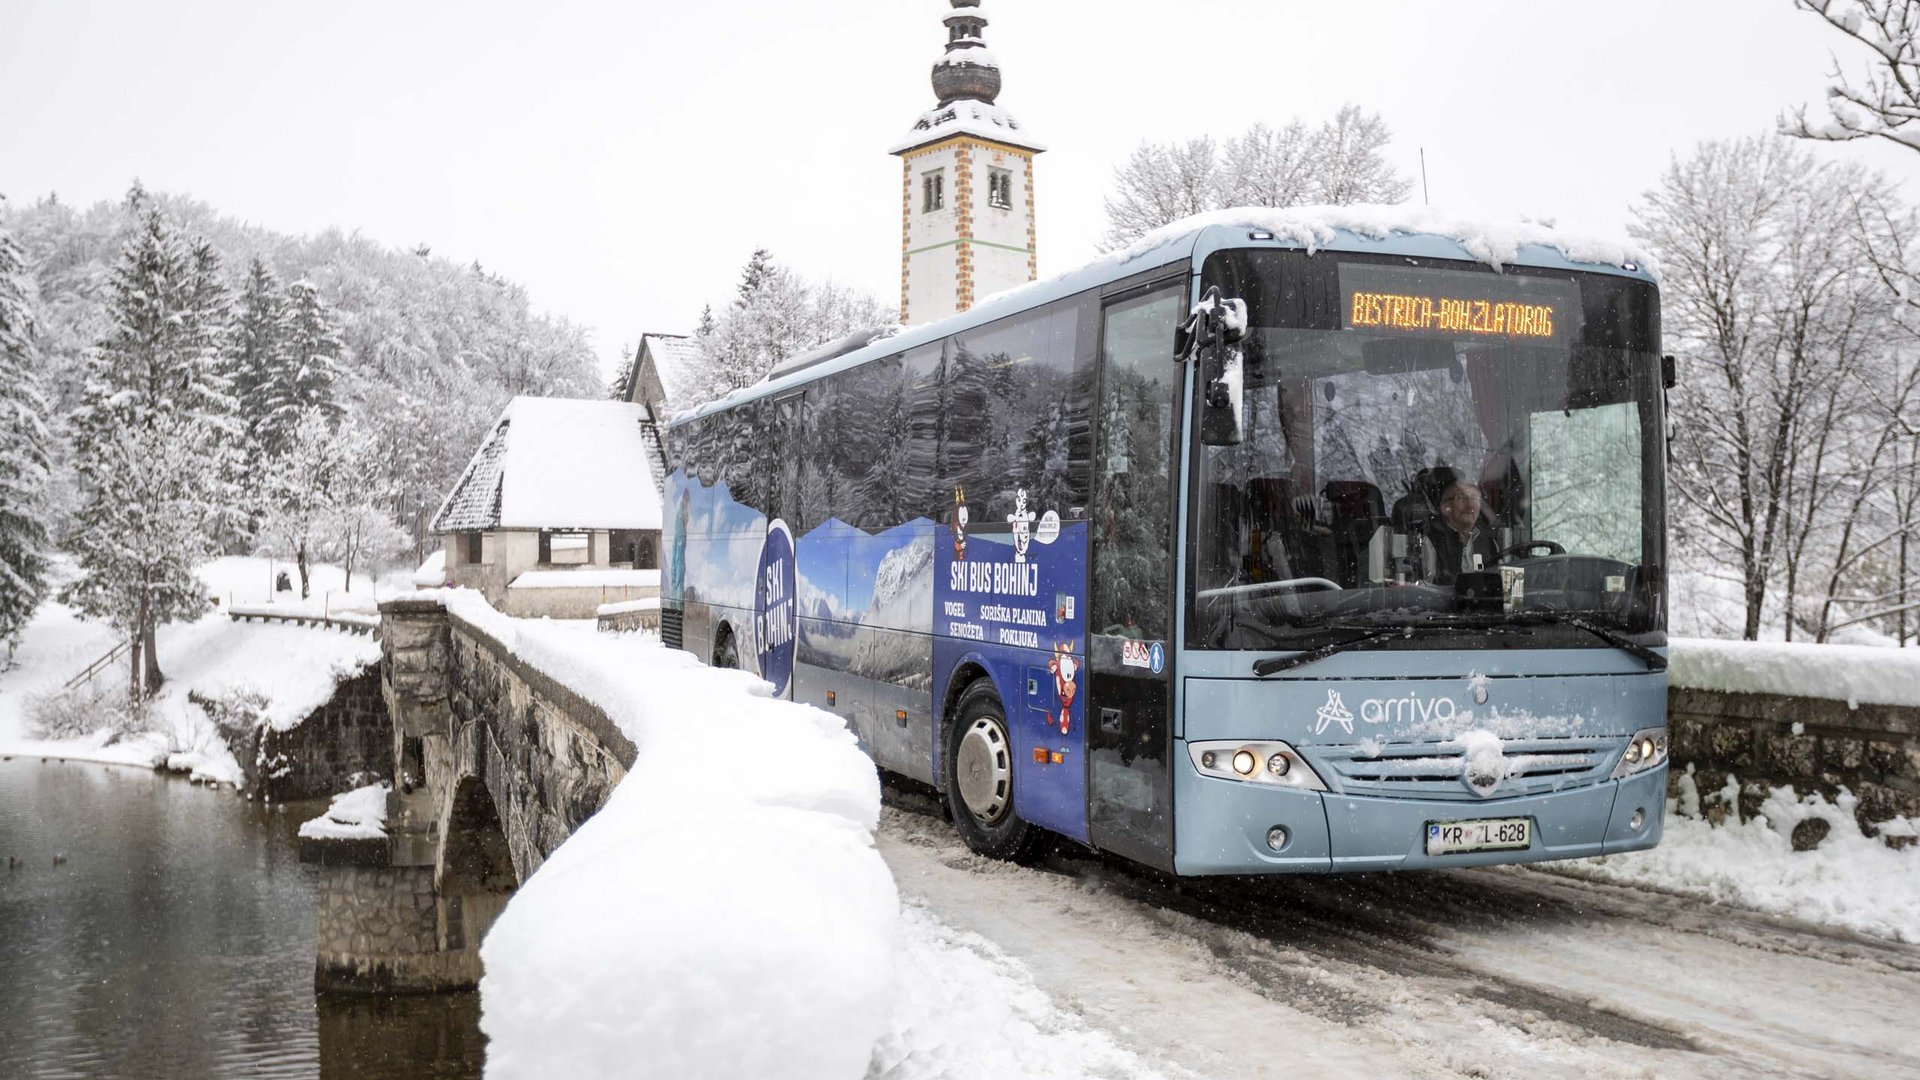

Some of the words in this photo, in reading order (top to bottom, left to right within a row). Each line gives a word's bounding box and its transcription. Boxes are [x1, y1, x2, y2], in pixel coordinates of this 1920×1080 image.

[766, 557, 783, 606] SKI
[950, 560, 968, 592] SKI
[970, 561, 992, 593] BUS
[994, 562, 1038, 596] BOHINJ
[944, 601, 966, 618] VOGEL
[980, 604, 1011, 623] SORIŠKA
[1012, 608, 1047, 627] PLANINA
[950, 621, 984, 640] SENOŽETA
[1000, 628, 1038, 648] POKLJUKA
[1360, 691, 1456, 723] arriva
[1442, 827, 1463, 845] KR
